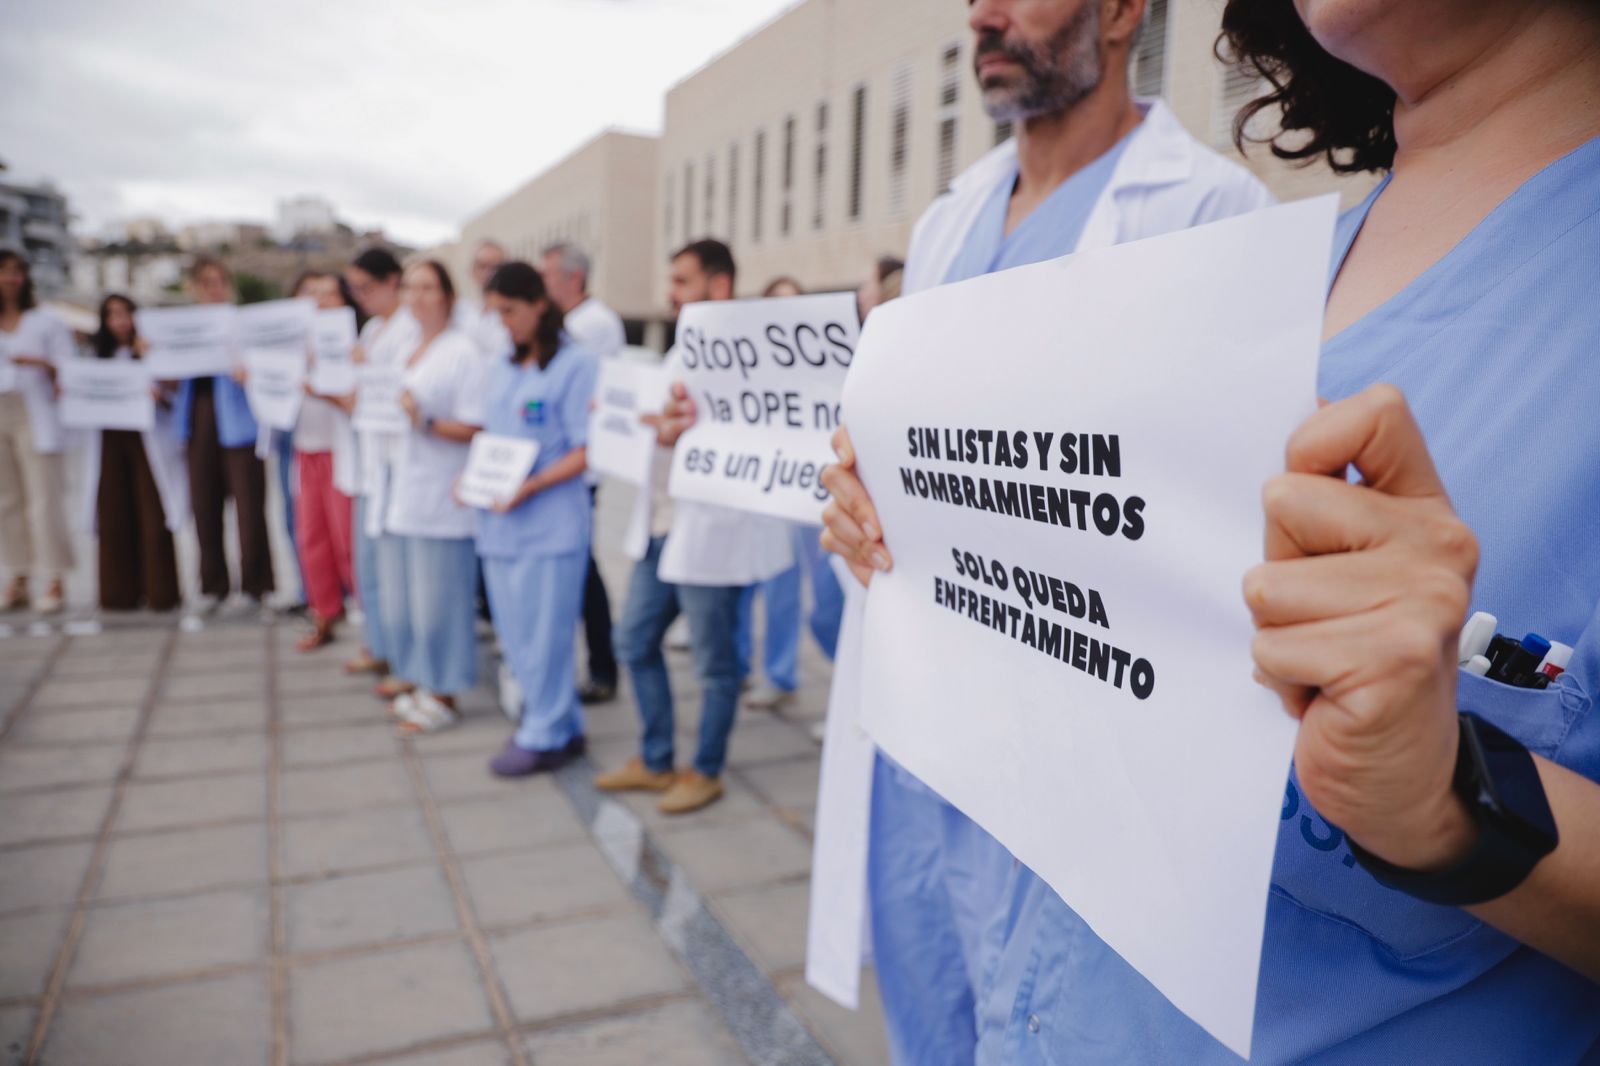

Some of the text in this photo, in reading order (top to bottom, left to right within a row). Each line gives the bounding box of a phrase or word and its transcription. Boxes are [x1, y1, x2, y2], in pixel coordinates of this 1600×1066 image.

[682, 321, 854, 379] Stop SCS
[704, 390, 732, 423] la
[740, 390, 802, 428] OPE
[684, 446, 717, 475] es
[724, 451, 761, 482] un
[907, 426, 1122, 478] SIN LISTAS Y SIN
[899, 466, 1146, 541] NOMBRAMIENTOS
[951, 547, 1110, 630] SOLO QUEDA
[933, 576, 1155, 700] ENFRENTAMIENTO
